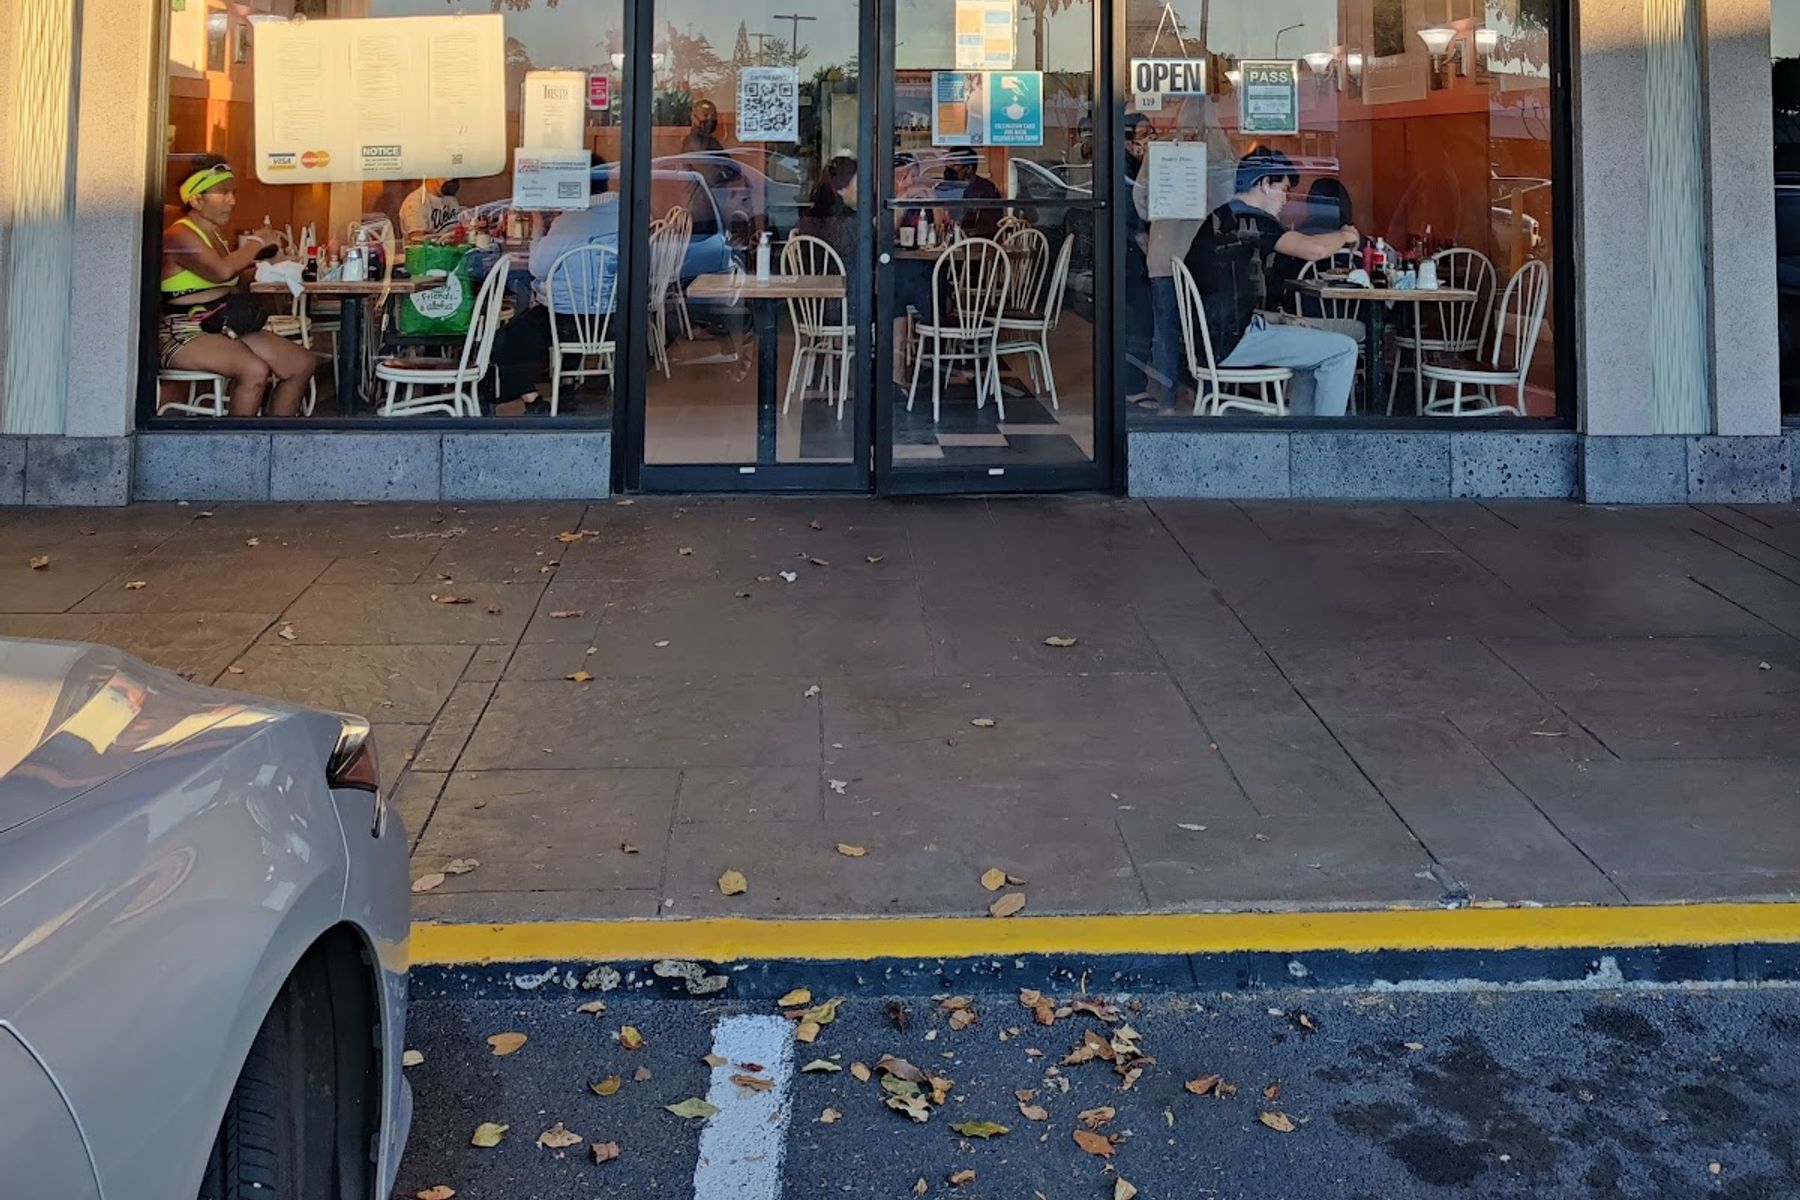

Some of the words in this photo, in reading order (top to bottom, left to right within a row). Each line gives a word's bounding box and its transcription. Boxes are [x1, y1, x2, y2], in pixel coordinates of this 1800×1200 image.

[1136, 62, 1201, 93] OPEN
[1250, 71, 1289, 83] PASS
[363, 147, 400, 156] NOTICE
[273, 157, 291, 165] VISA
